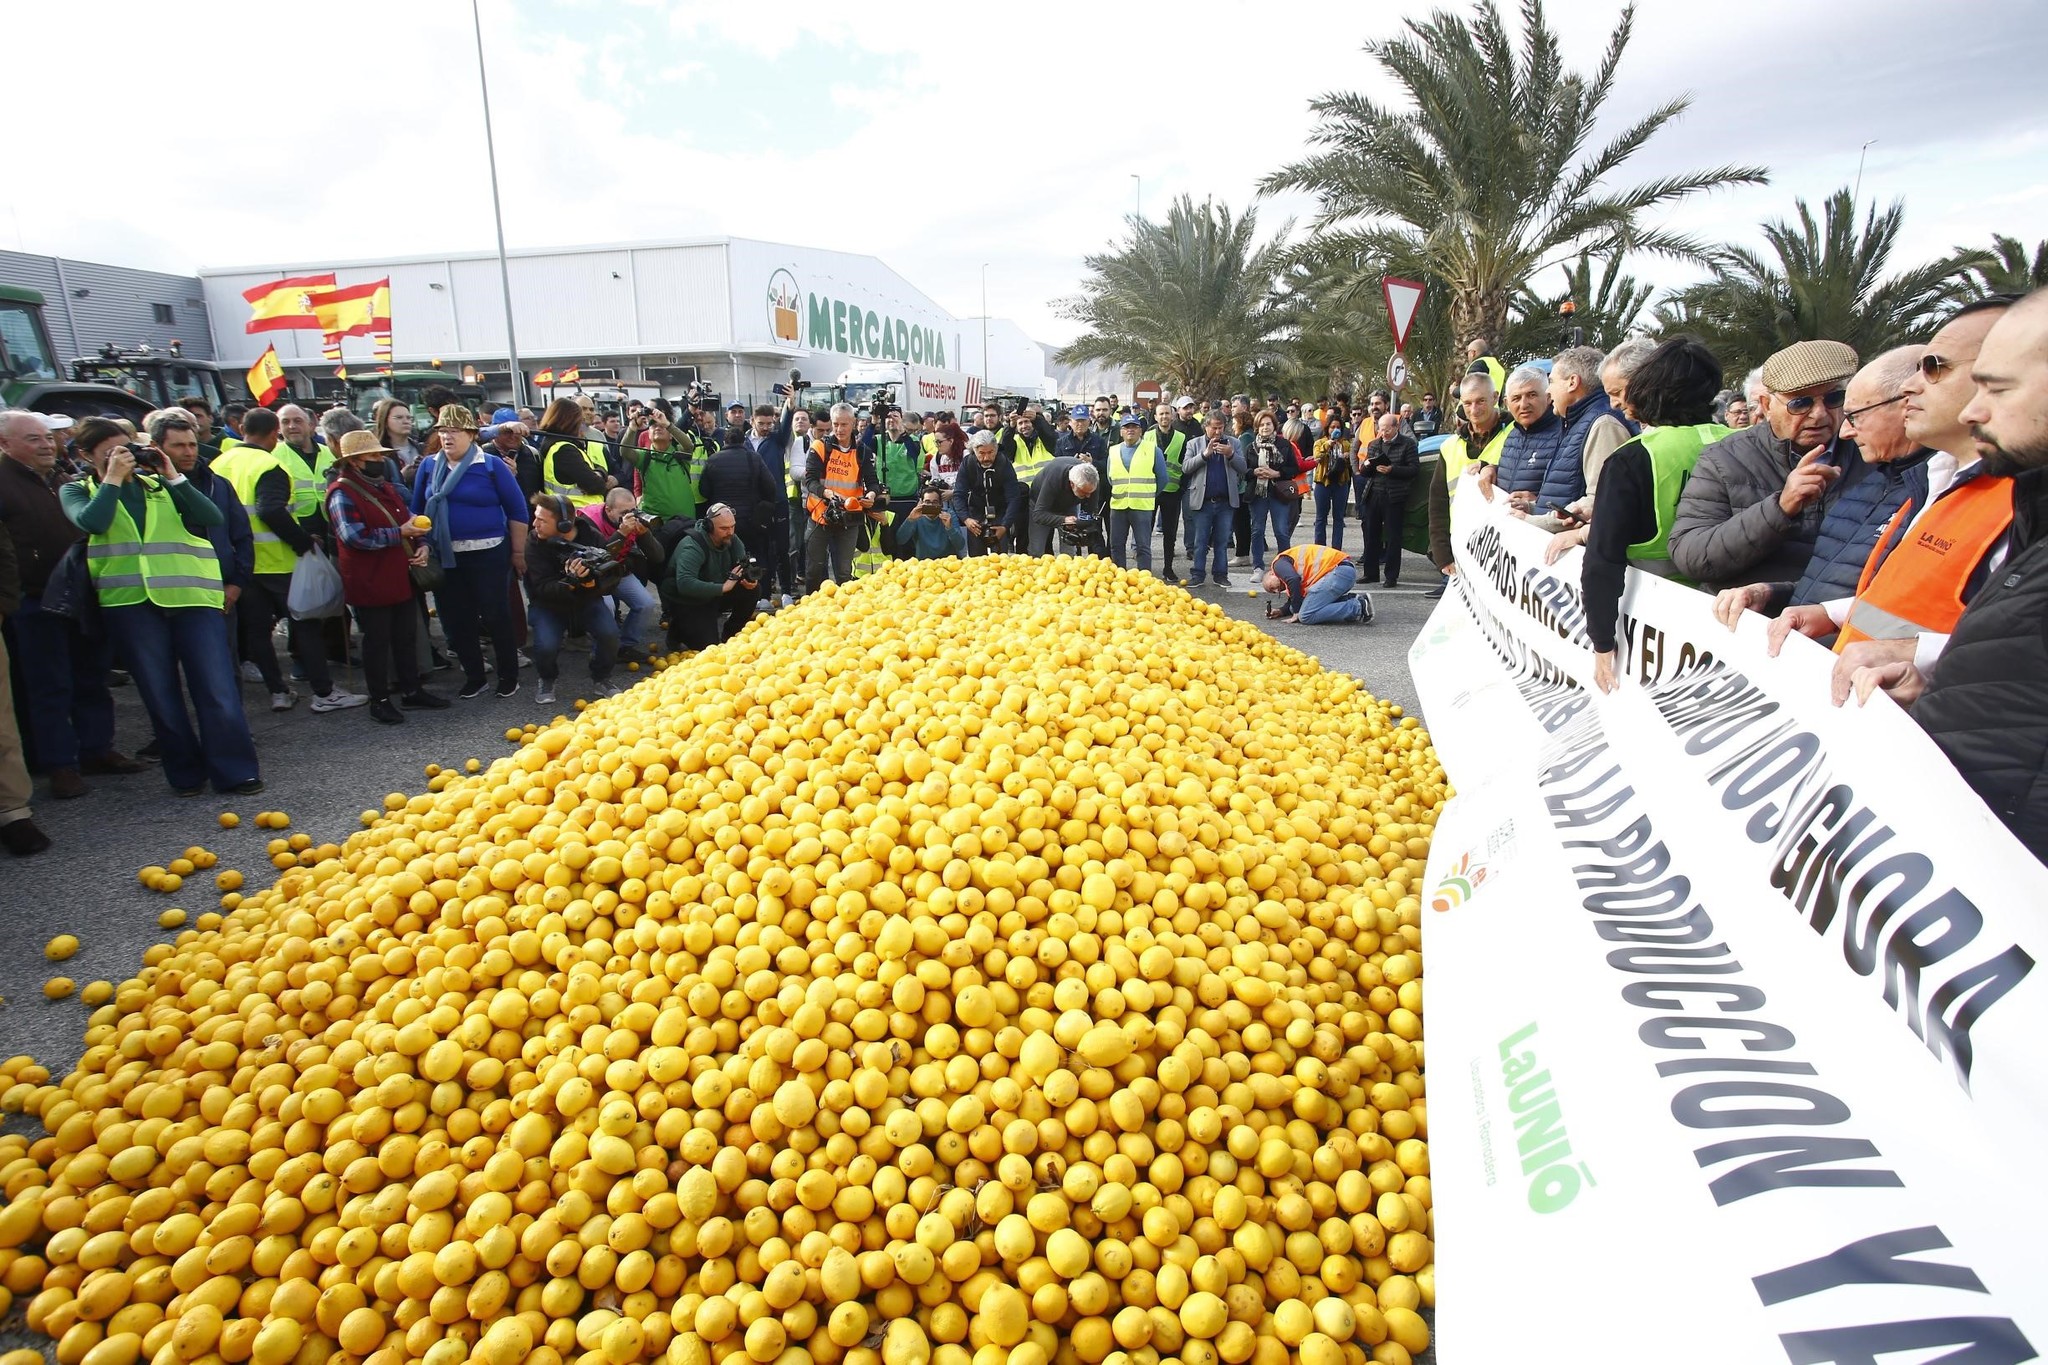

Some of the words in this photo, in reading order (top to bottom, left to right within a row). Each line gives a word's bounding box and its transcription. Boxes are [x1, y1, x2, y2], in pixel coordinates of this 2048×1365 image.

[808, 292, 946, 369] MERCADONA
[918, 376, 957, 404] transleyca
[828, 467, 849, 476] PRESS
[829, 458, 852, 468] RENSA
[1920, 532, 1934, 545] LA
[1623, 613, 1638, 675] Y
[1640, 624, 1665, 688] EL
[1544, 764, 1636, 829] LA
[1562, 813, 1907, 1208] PRODUCCION
[1479, 1120, 1497, 1187] Ramadera
